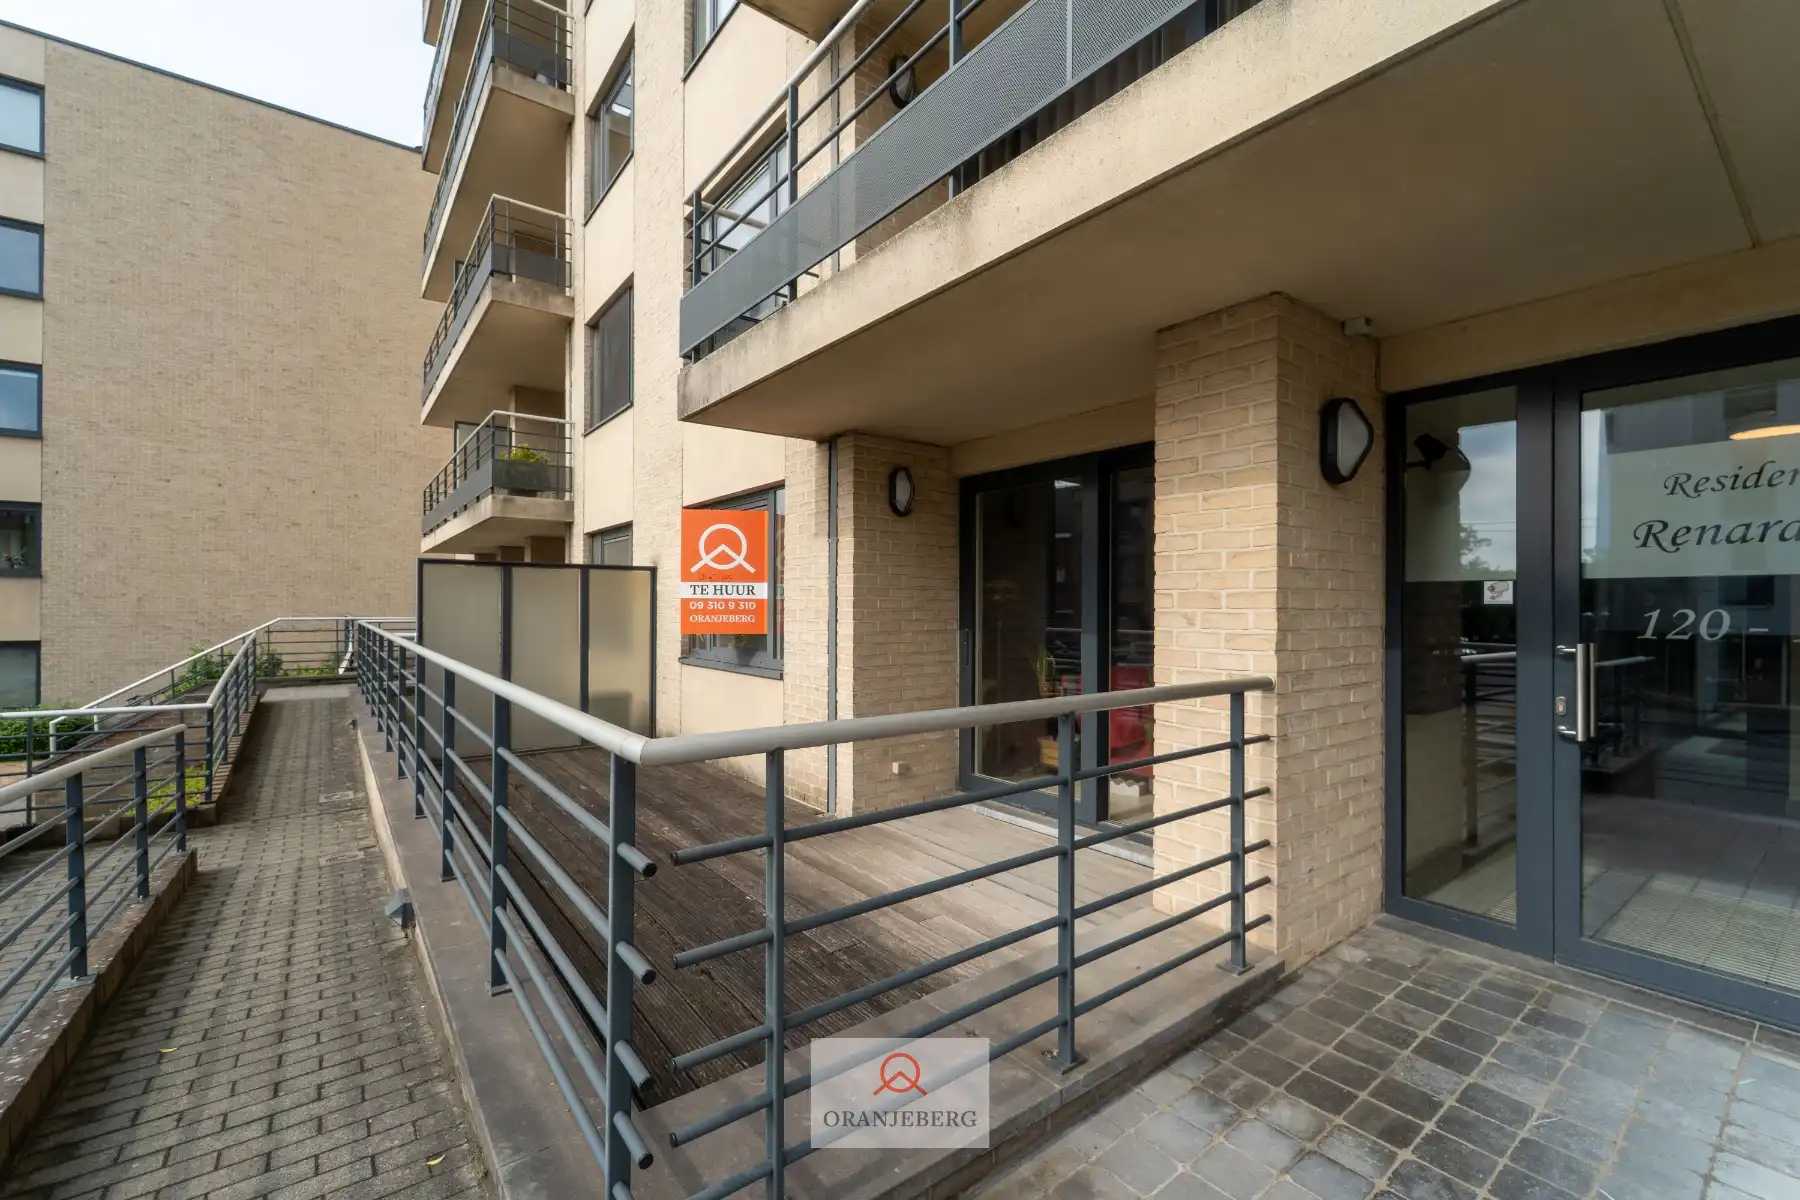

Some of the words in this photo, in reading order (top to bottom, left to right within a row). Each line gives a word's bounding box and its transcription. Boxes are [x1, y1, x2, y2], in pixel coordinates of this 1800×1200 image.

[690, 585, 709, 596] TE
[713, 585, 756, 596] HUUR
[689, 601, 704, 610] 09
[707, 601, 725, 610] 310
[728, 601, 735, 610] 9
[738, 601, 756, 610] 310
[689, 614, 755, 623] ORANJEBERG
[1637, 608, 1731, 641] 120
